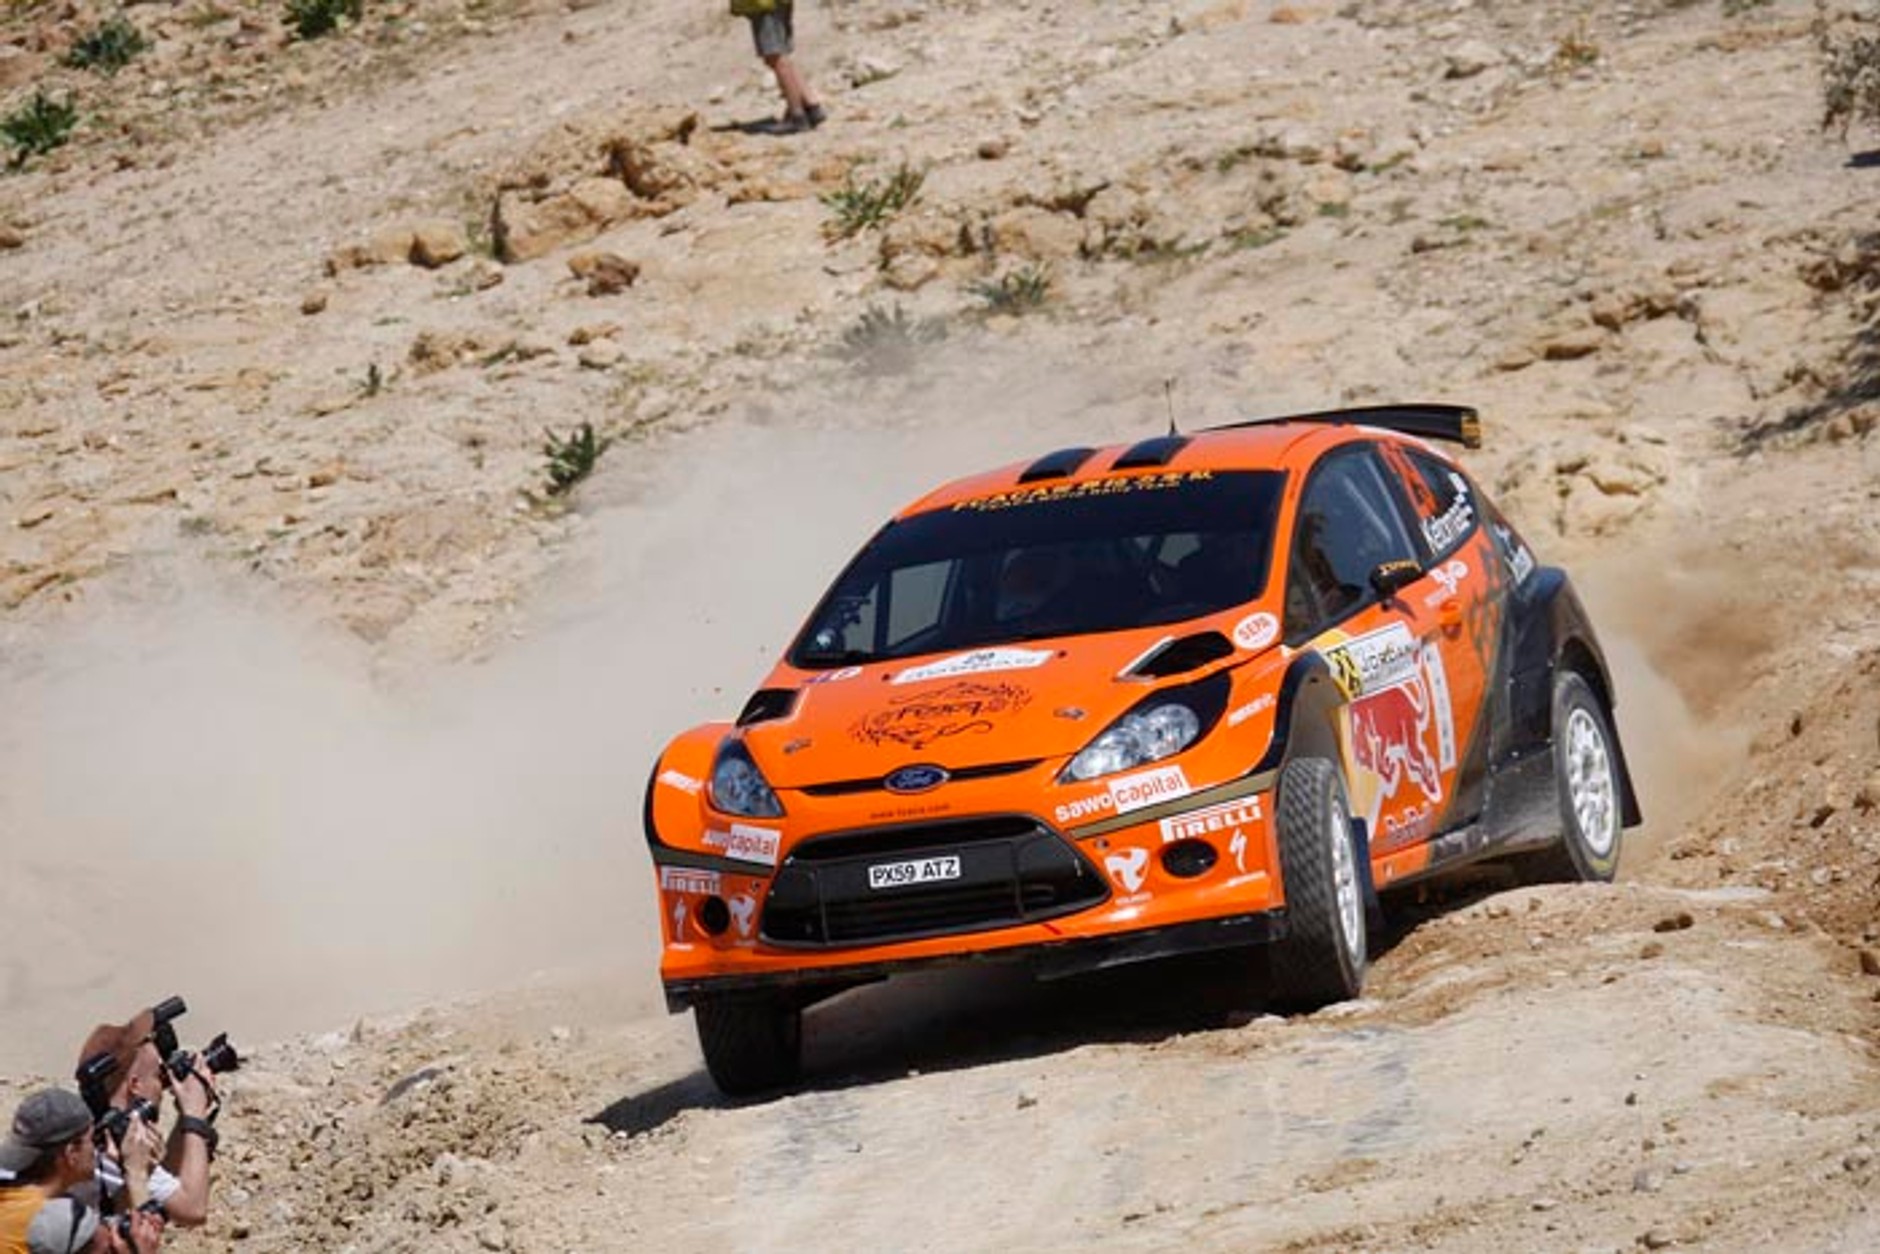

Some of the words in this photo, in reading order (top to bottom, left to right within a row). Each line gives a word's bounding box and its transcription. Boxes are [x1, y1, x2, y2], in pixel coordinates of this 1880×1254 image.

[1238, 615, 1272, 641] SEPA
[898, 769, 931, 788] Ford
[1055, 794, 1114, 822] sawo
[1115, 773, 1184, 808] capital
[1159, 795, 1261, 843] PIRELLI
[730, 834, 776, 856] capital
[873, 864, 917, 884] PX59
[922, 859, 957, 879] ATZ
